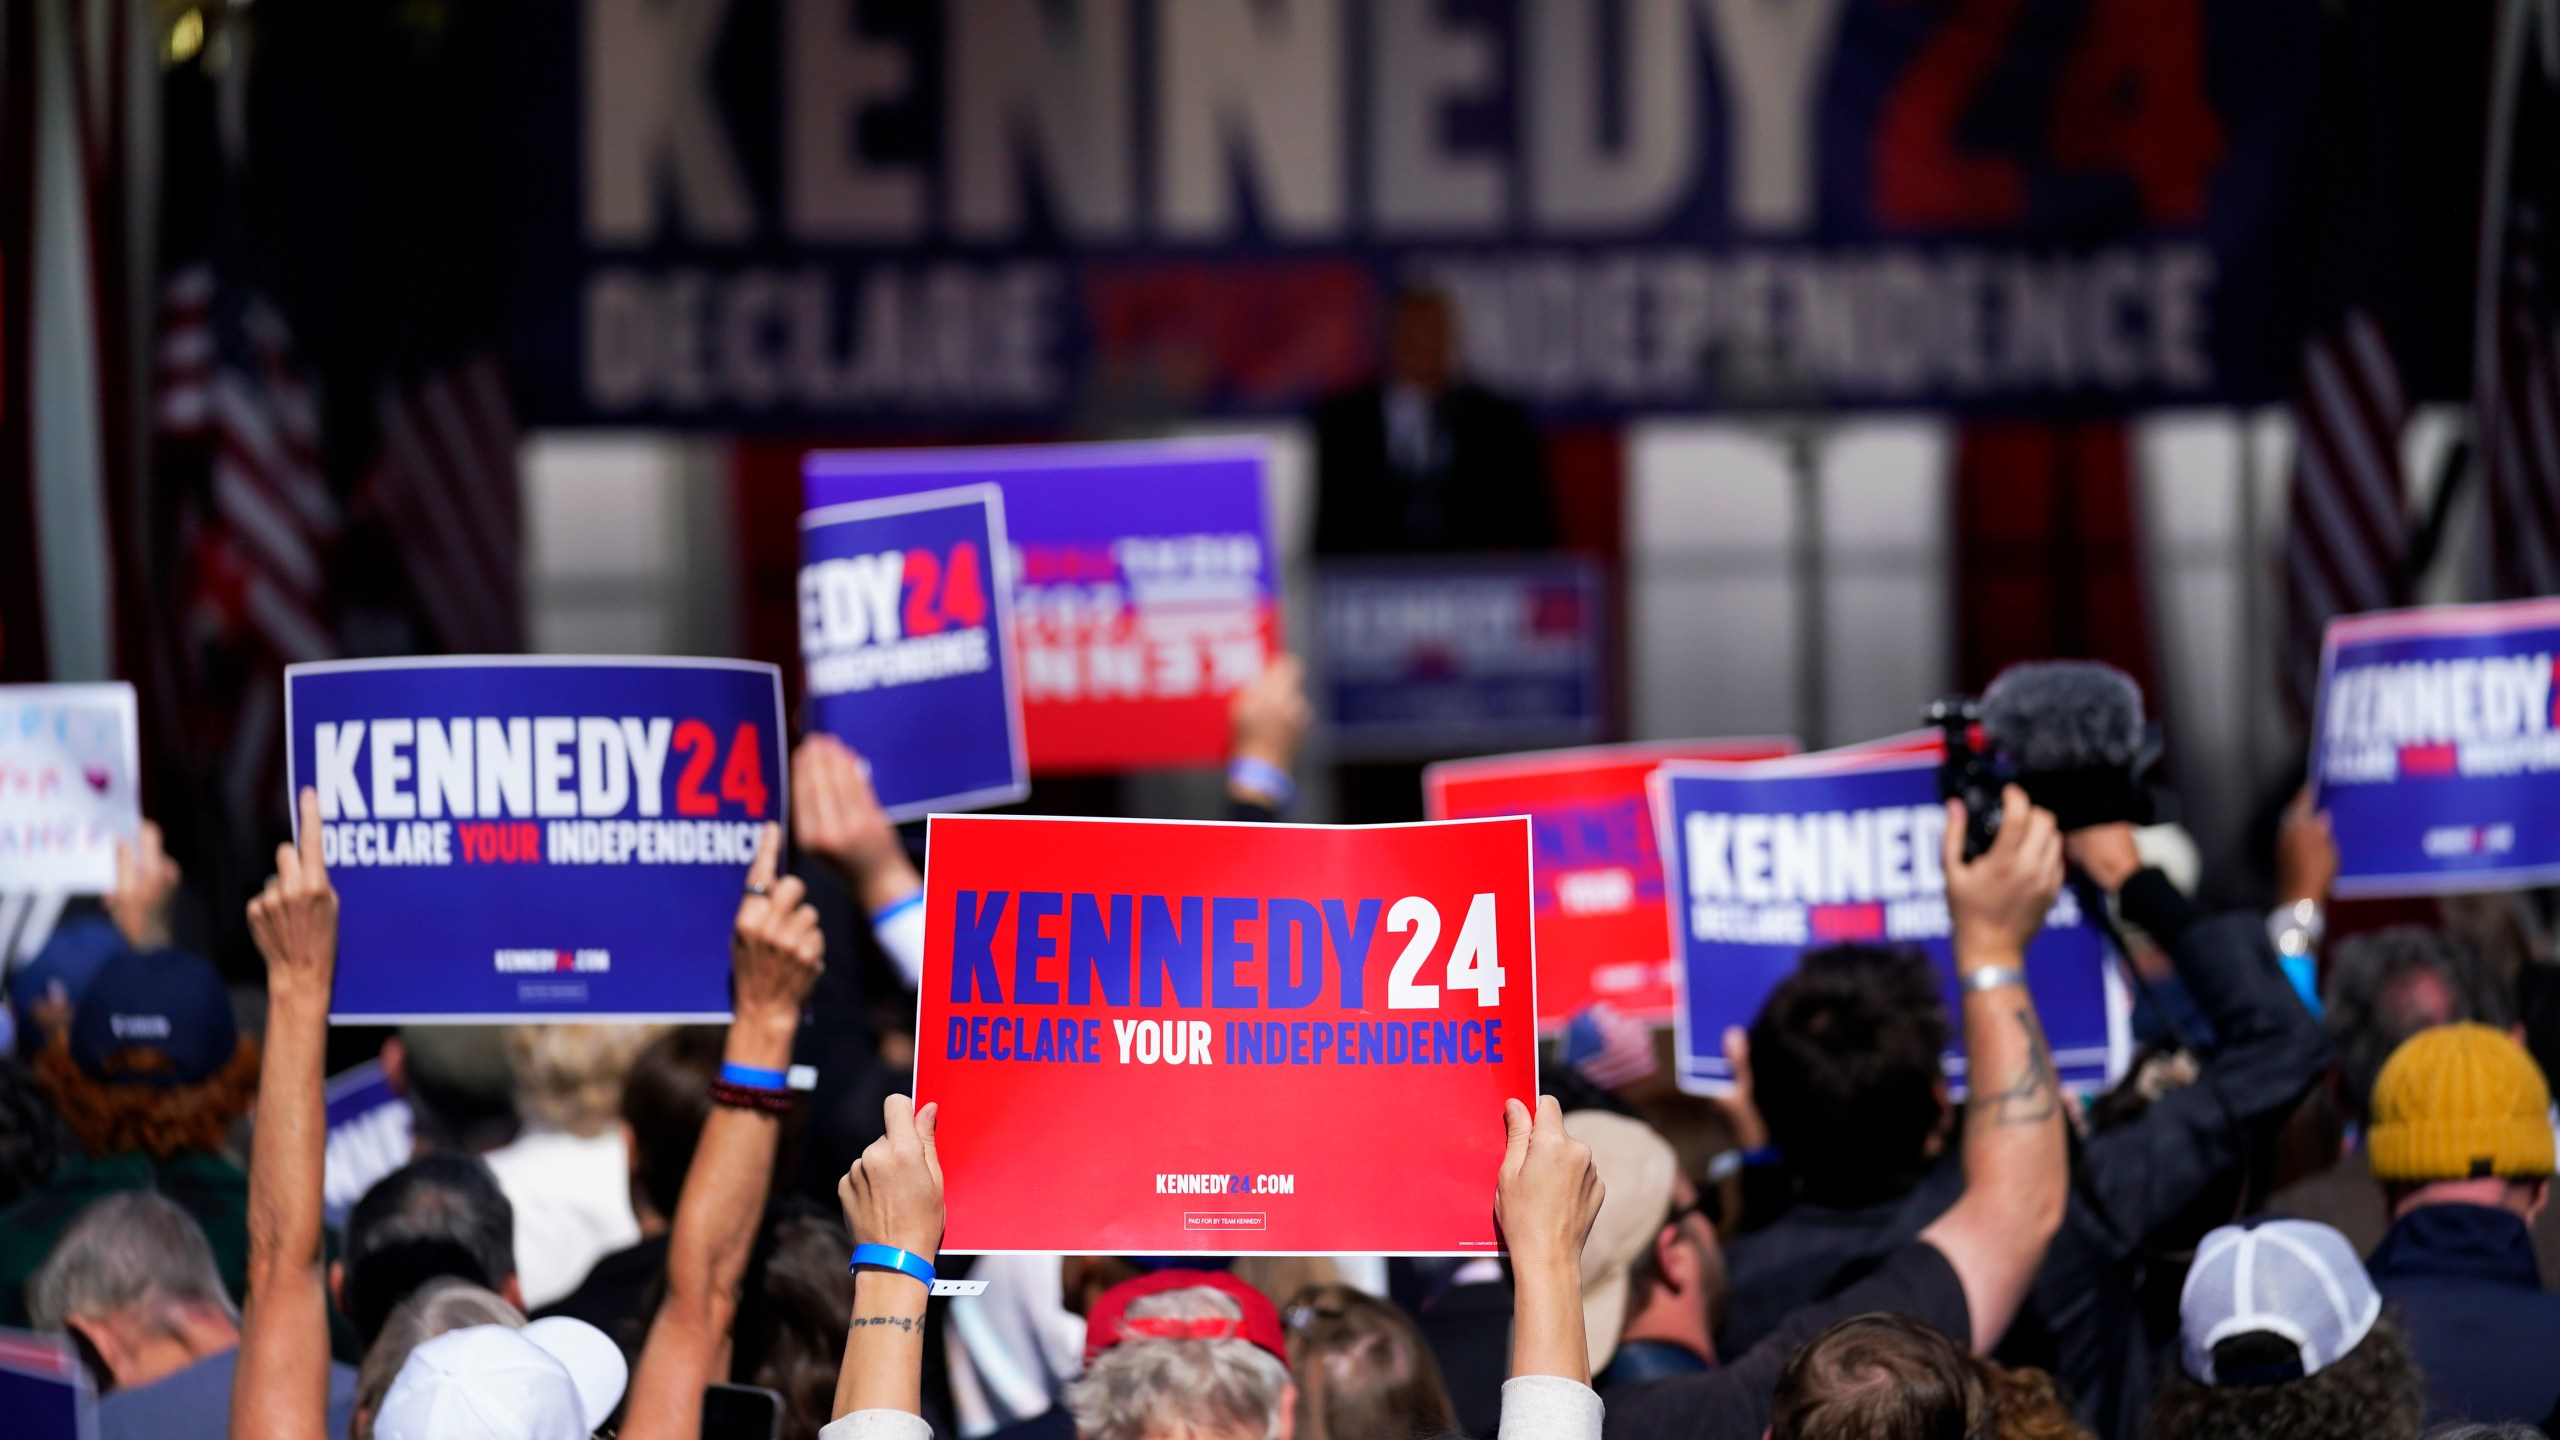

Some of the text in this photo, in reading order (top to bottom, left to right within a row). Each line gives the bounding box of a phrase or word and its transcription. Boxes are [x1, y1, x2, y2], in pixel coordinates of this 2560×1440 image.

[582, 0, 2226, 243] KENNEDY24
[583, 260, 1062, 410] DECLARE
[2325, 651, 2560, 743] KENNEDY
[315, 717, 767, 819] KENNEDY24
[323, 821, 452, 867] DECLARE
[458, 823, 540, 863] YOUR
[1686, 804, 1949, 902] KENNED
[950, 890, 1506, 1010] KENNEDY24
[946, 1016, 1504, 1065] DECLARE YOUR INDEPENDENCE
[1156, 1174, 1294, 1194] KENNEDY24.COM
